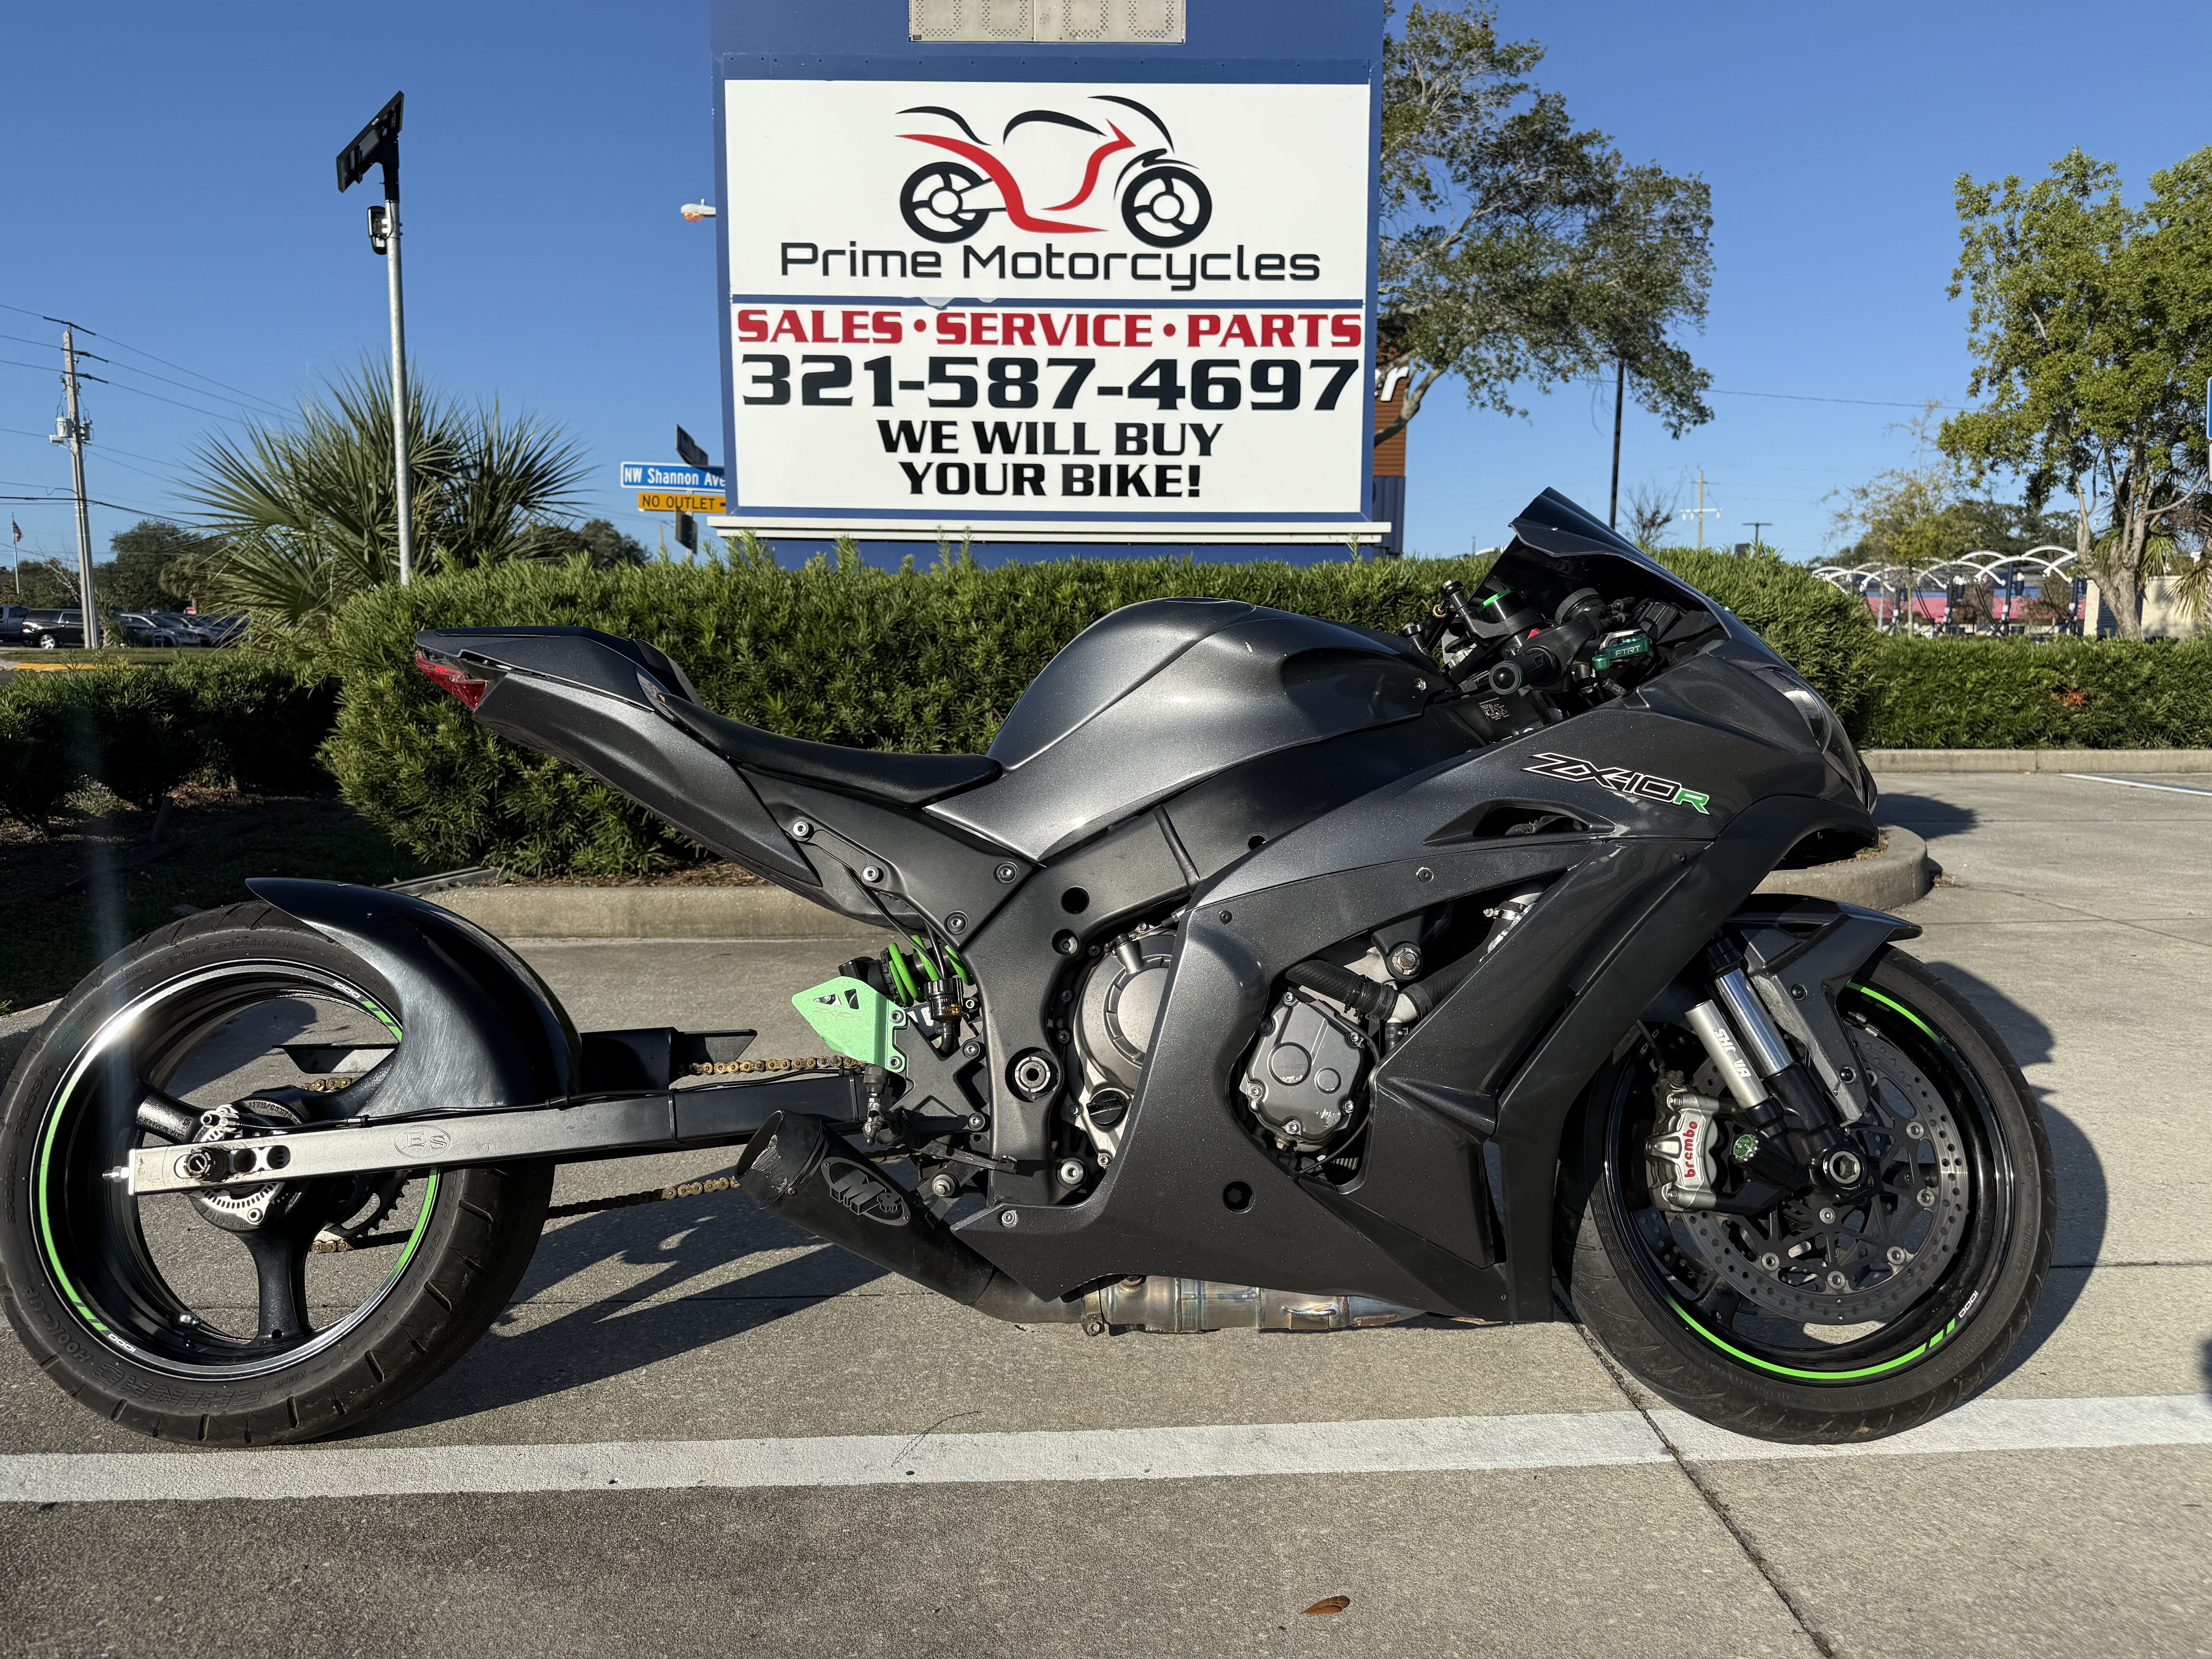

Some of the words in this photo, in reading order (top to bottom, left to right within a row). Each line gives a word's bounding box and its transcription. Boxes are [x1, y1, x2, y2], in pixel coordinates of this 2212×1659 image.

[781, 241, 942, 278] Prime
[963, 242, 1319, 290] Motorcycles
[738, 309, 902, 344] SALES
[936, 312, 1152, 347] SERVICE
[1187, 314, 1362, 348] PARTS
[743, 354, 1358, 410] 321-587-4697
[877, 420, 958, 453] WE
[972, 421, 1100, 455] WILL
[1115, 423, 1223, 456] BUY
[625, 467, 642, 483] NW
[647, 468, 699, 485] Shannon
[704, 472, 725, 487] Ave
[899, 462, 1046, 496] YOUR
[1062, 464, 1200, 497] BIKE!
[642, 495, 660, 508] NO
[666, 496, 715, 510] OUTLET
[1615, 645, 1641, 656] FTRT
[333, 982, 361, 999] 1000
[1683, 1121, 1698, 1178] brembo
[1958, 1290, 1978, 1318] 1000
[22, 1286, 94, 1364] HOOK-UP
[108, 1334, 136, 1352] 1000
[93, 1359, 266, 1409] SHINKO
